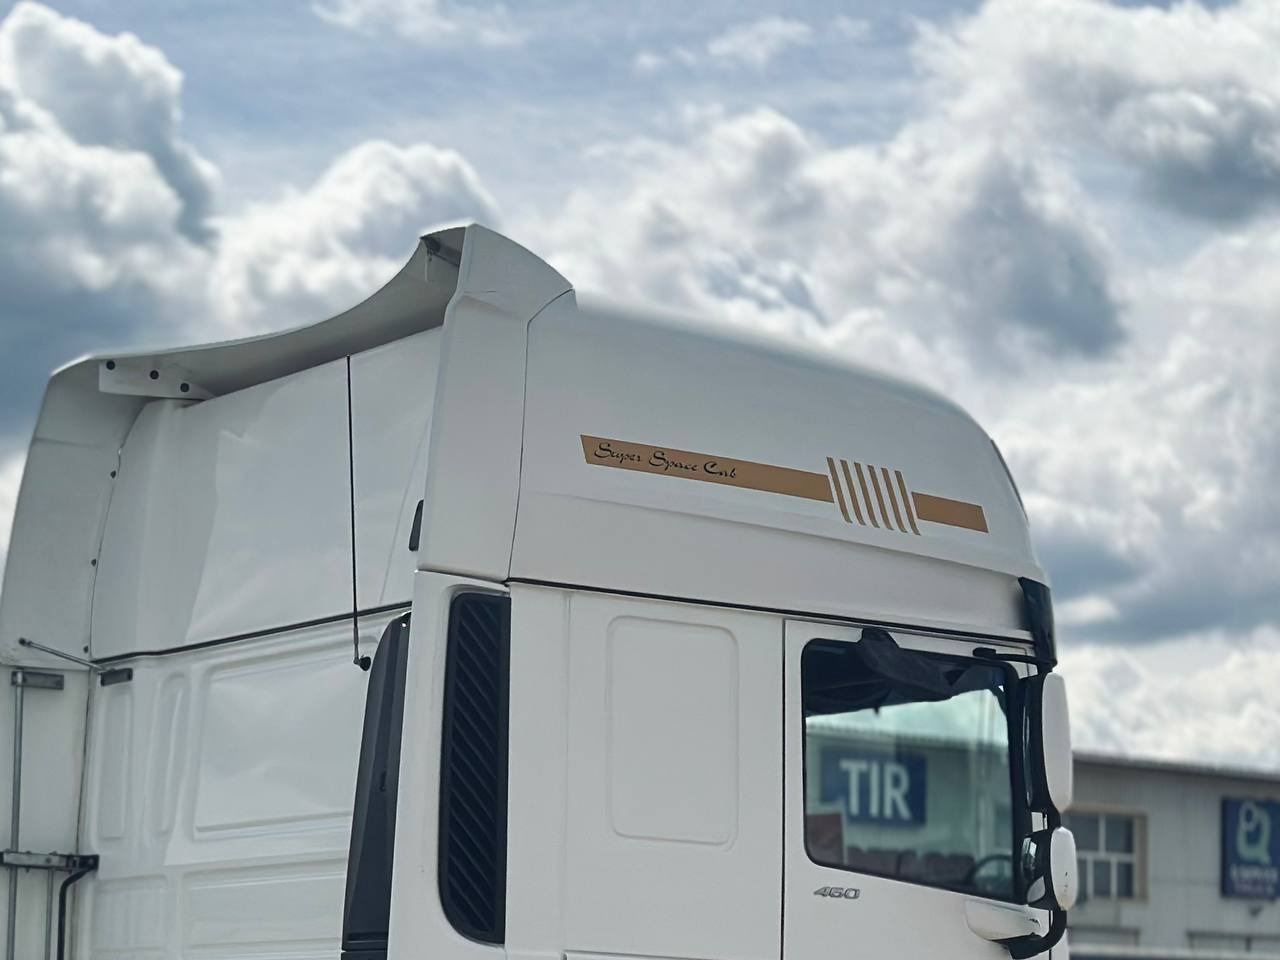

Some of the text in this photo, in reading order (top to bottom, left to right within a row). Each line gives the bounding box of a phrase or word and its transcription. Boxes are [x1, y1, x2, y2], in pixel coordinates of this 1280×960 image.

[594, 442, 737, 479] Super Space Cab
[839, 758, 913, 821] TIR
[813, 886, 861, 900] 460
